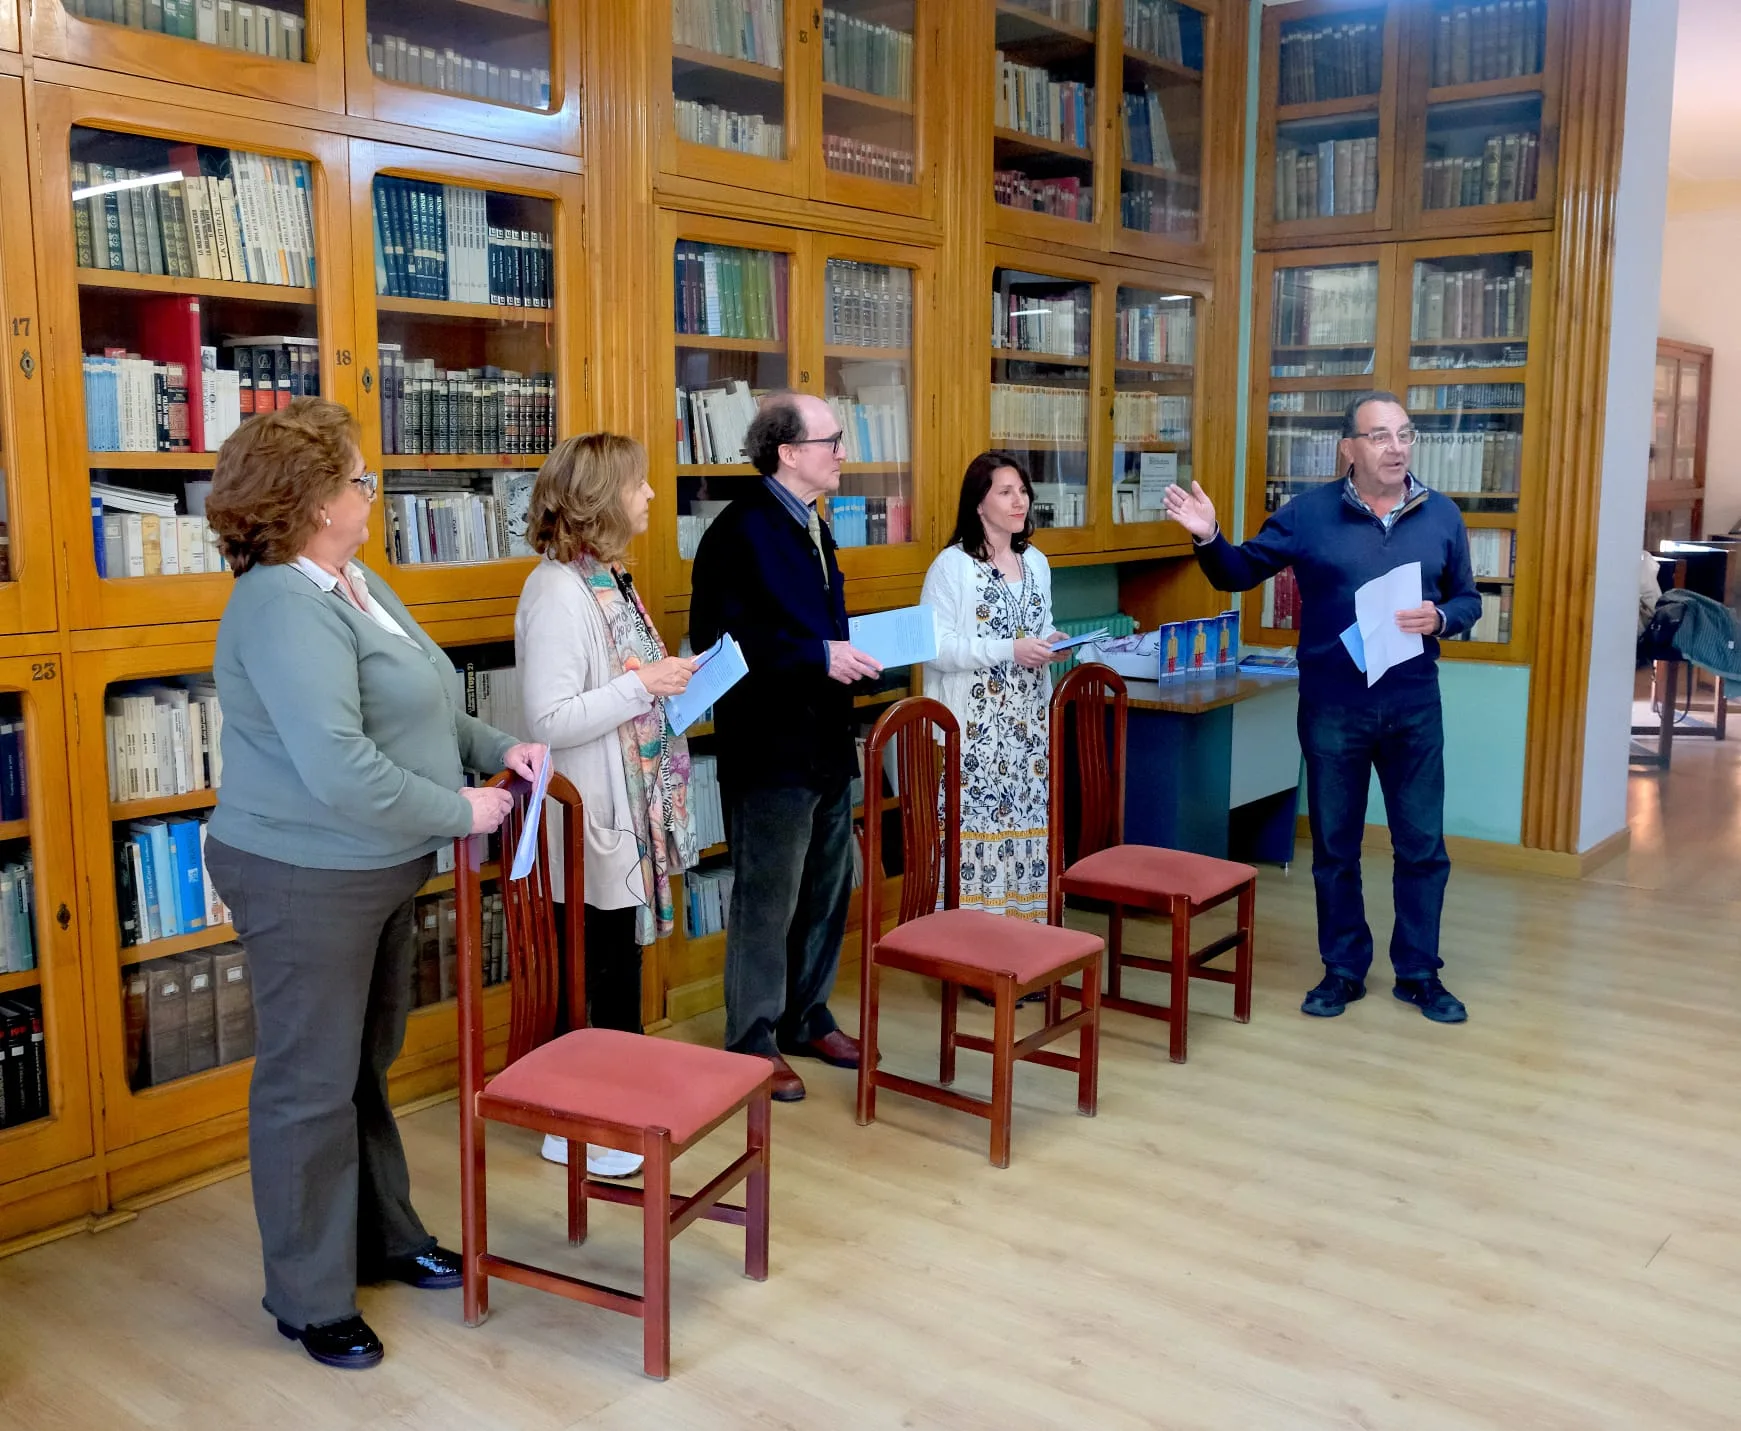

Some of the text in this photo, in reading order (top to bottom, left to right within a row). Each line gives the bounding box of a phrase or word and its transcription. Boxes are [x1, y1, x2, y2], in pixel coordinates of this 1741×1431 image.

[12, 317, 30, 336] 17
[336, 350, 352, 365] 18
[32, 662, 56, 681] 23
[467, 671, 475, 692] Troya
